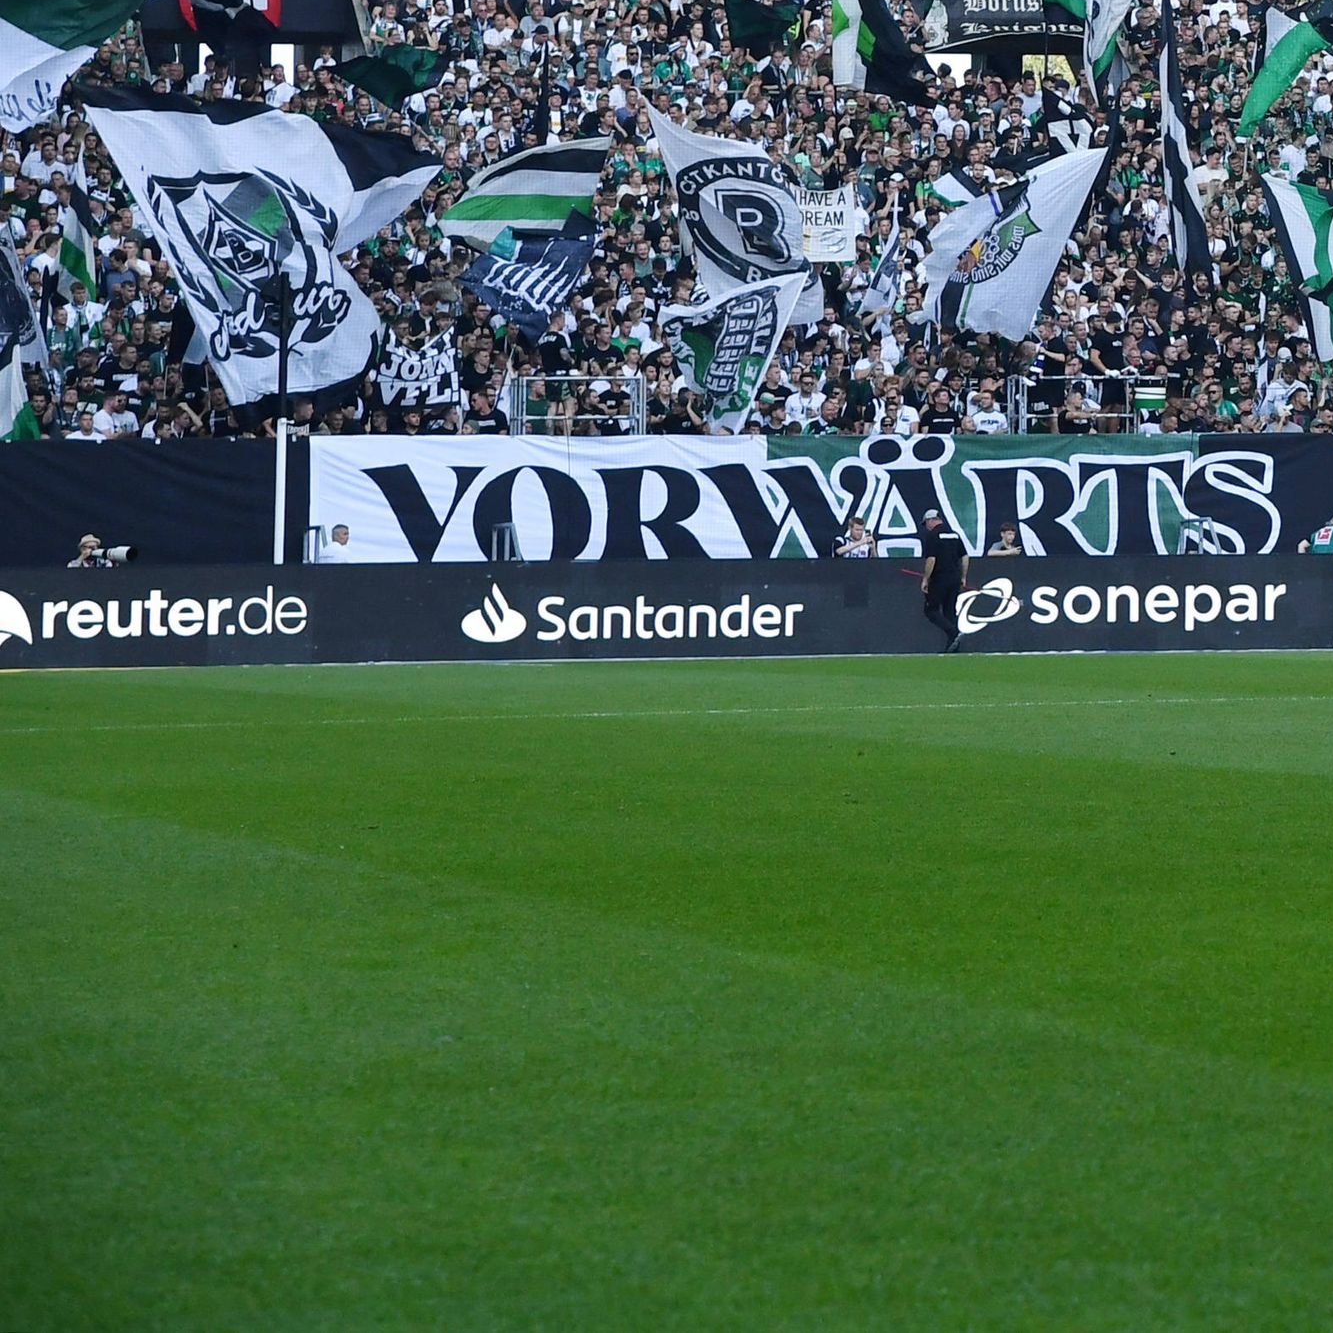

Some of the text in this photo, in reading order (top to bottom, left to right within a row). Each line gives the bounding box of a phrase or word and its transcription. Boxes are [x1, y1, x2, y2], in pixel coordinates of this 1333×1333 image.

[799, 191, 833, 206] HAVE
[838, 190, 846, 205] A
[362, 433, 1282, 563] VORWÄRTS
[42, 585, 308, 639] reuter.de
[536, 593, 806, 641] Santander
[1029, 582, 1287, 631] sonepar
